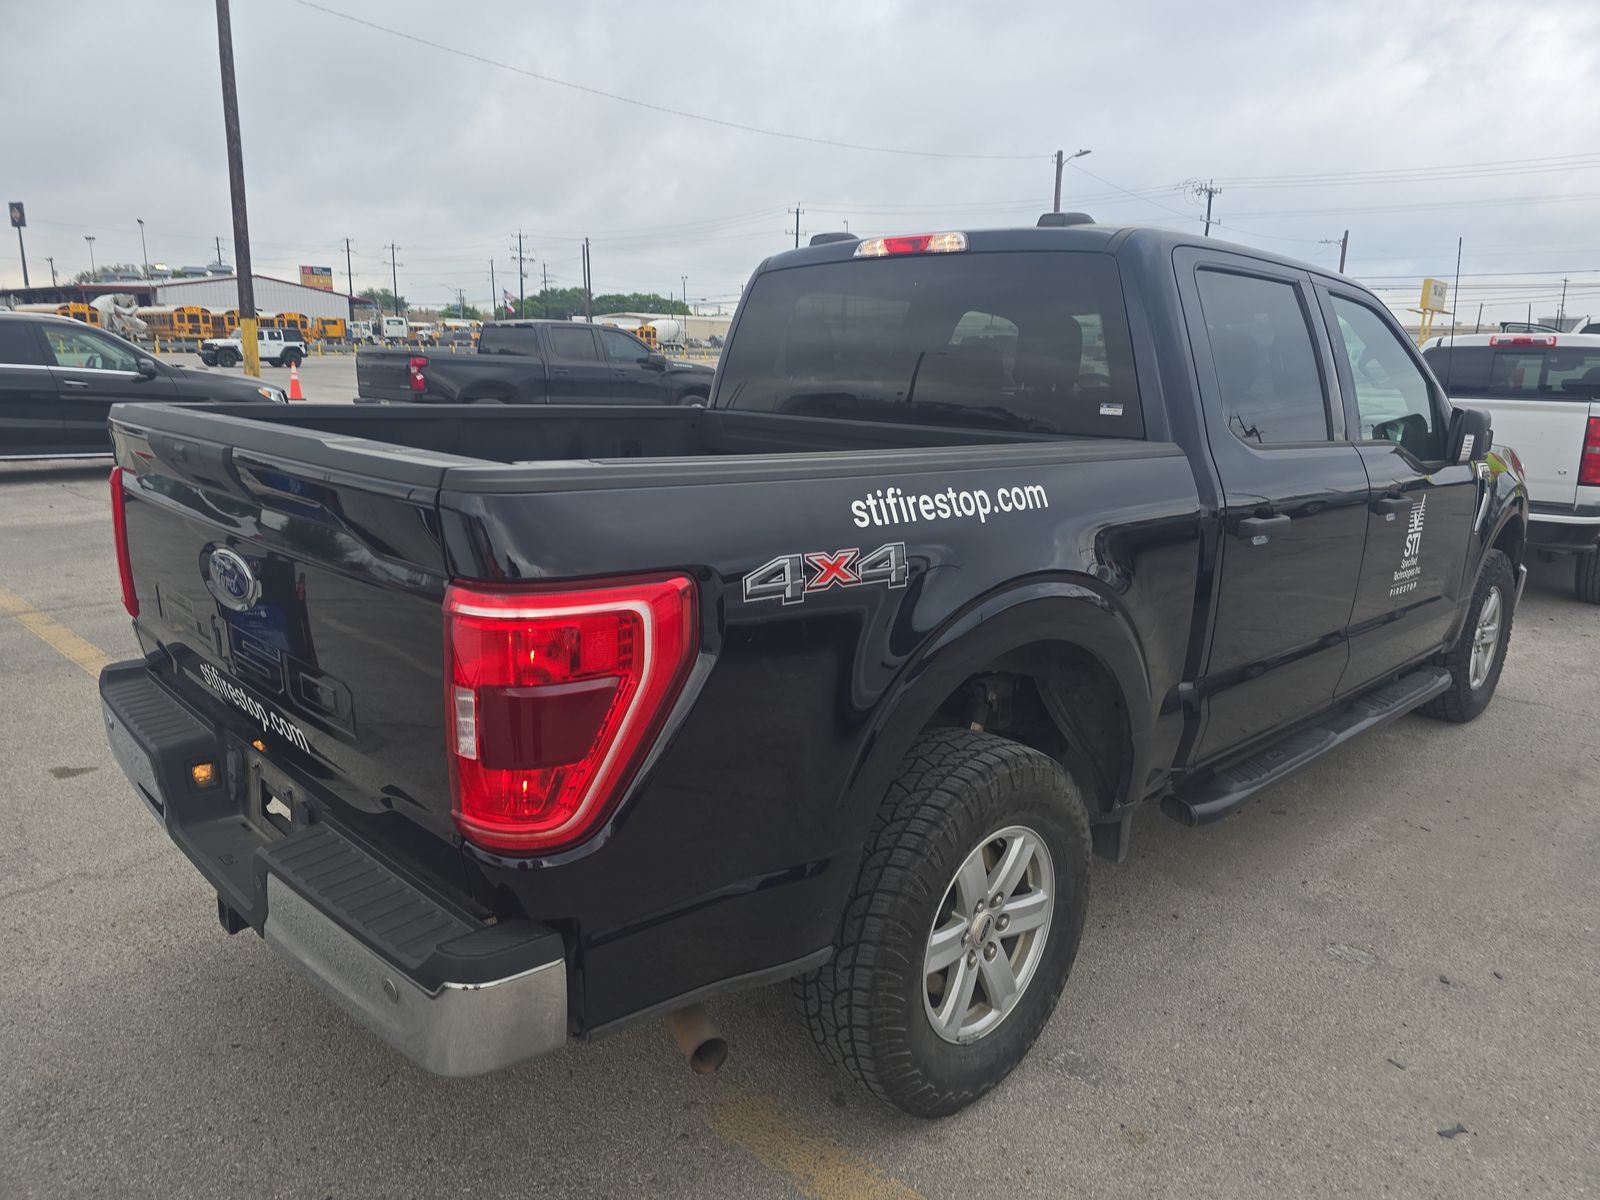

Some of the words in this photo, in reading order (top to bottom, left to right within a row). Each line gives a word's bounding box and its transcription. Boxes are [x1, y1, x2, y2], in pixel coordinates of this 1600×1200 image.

[851, 484, 1049, 528] stifirestop.com
[1404, 532, 1421, 557] STI
[214, 555, 239, 593] Ford
[200, 664, 312, 754] stifirestop.com
